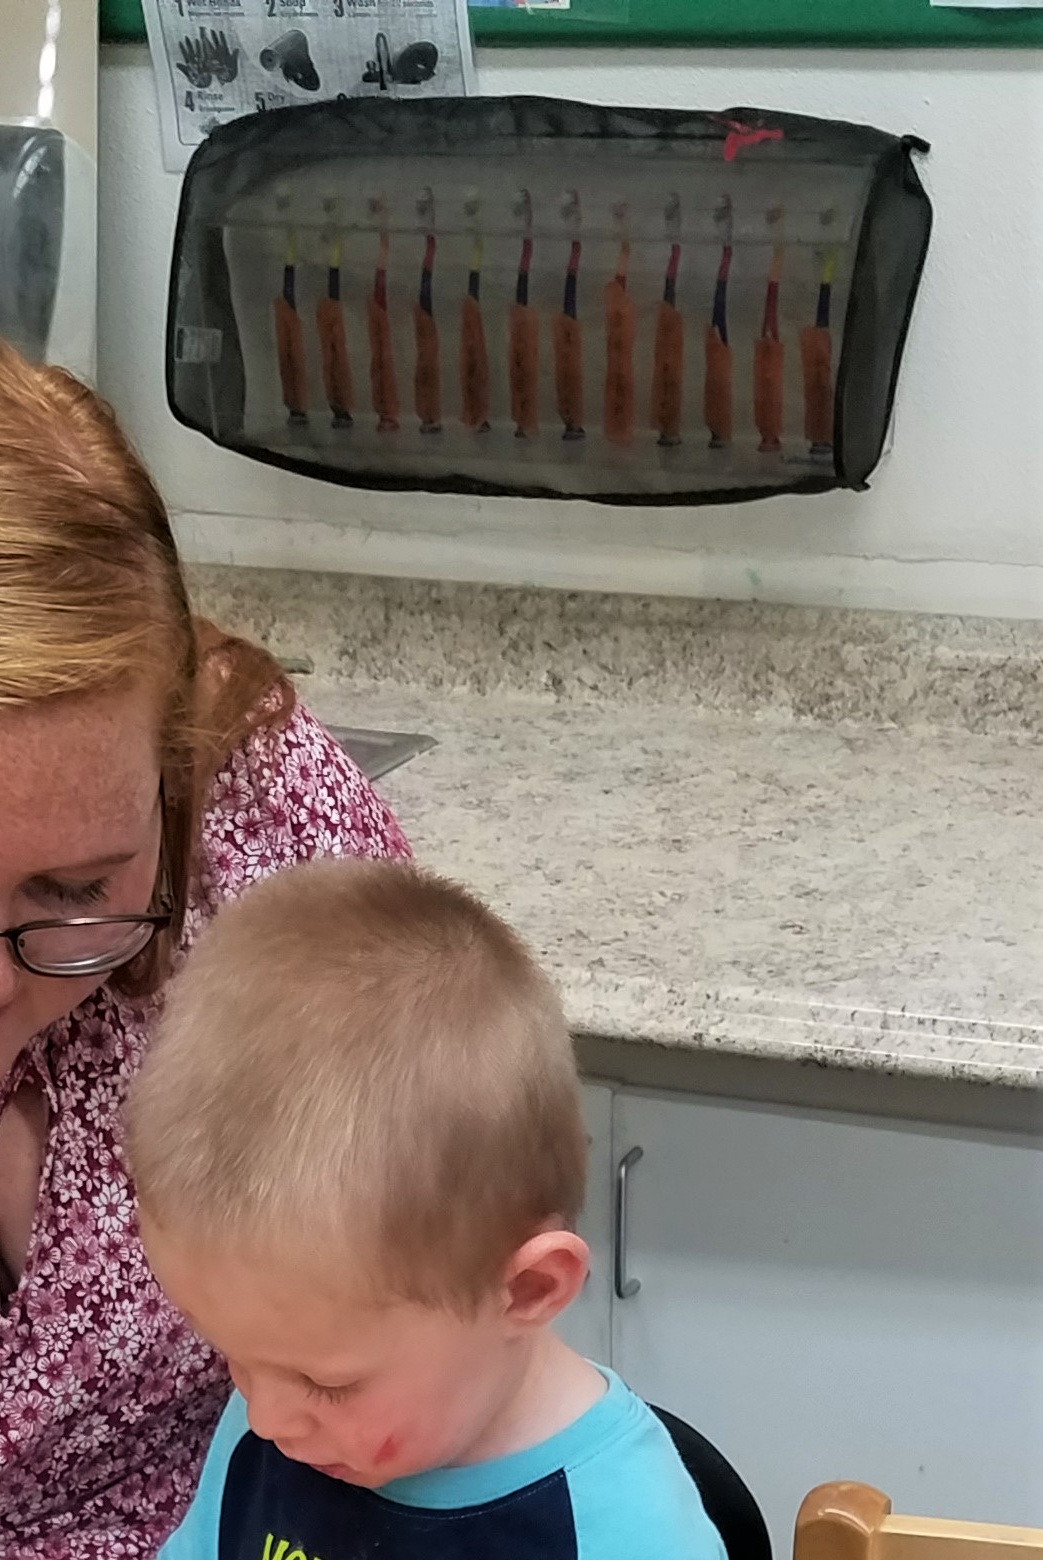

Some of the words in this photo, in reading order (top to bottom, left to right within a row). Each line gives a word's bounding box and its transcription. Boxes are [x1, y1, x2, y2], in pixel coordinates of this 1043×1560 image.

[266, 0, 276, 17] 2
[279, 0, 306, 14] Soap
[347, 0, 376, 8] Wash
[184, 90, 195, 112] 4
[197, 91, 224, 101] Rinse
[254, 92, 266, 112] 5
[267, 92, 285, 104] Dry
